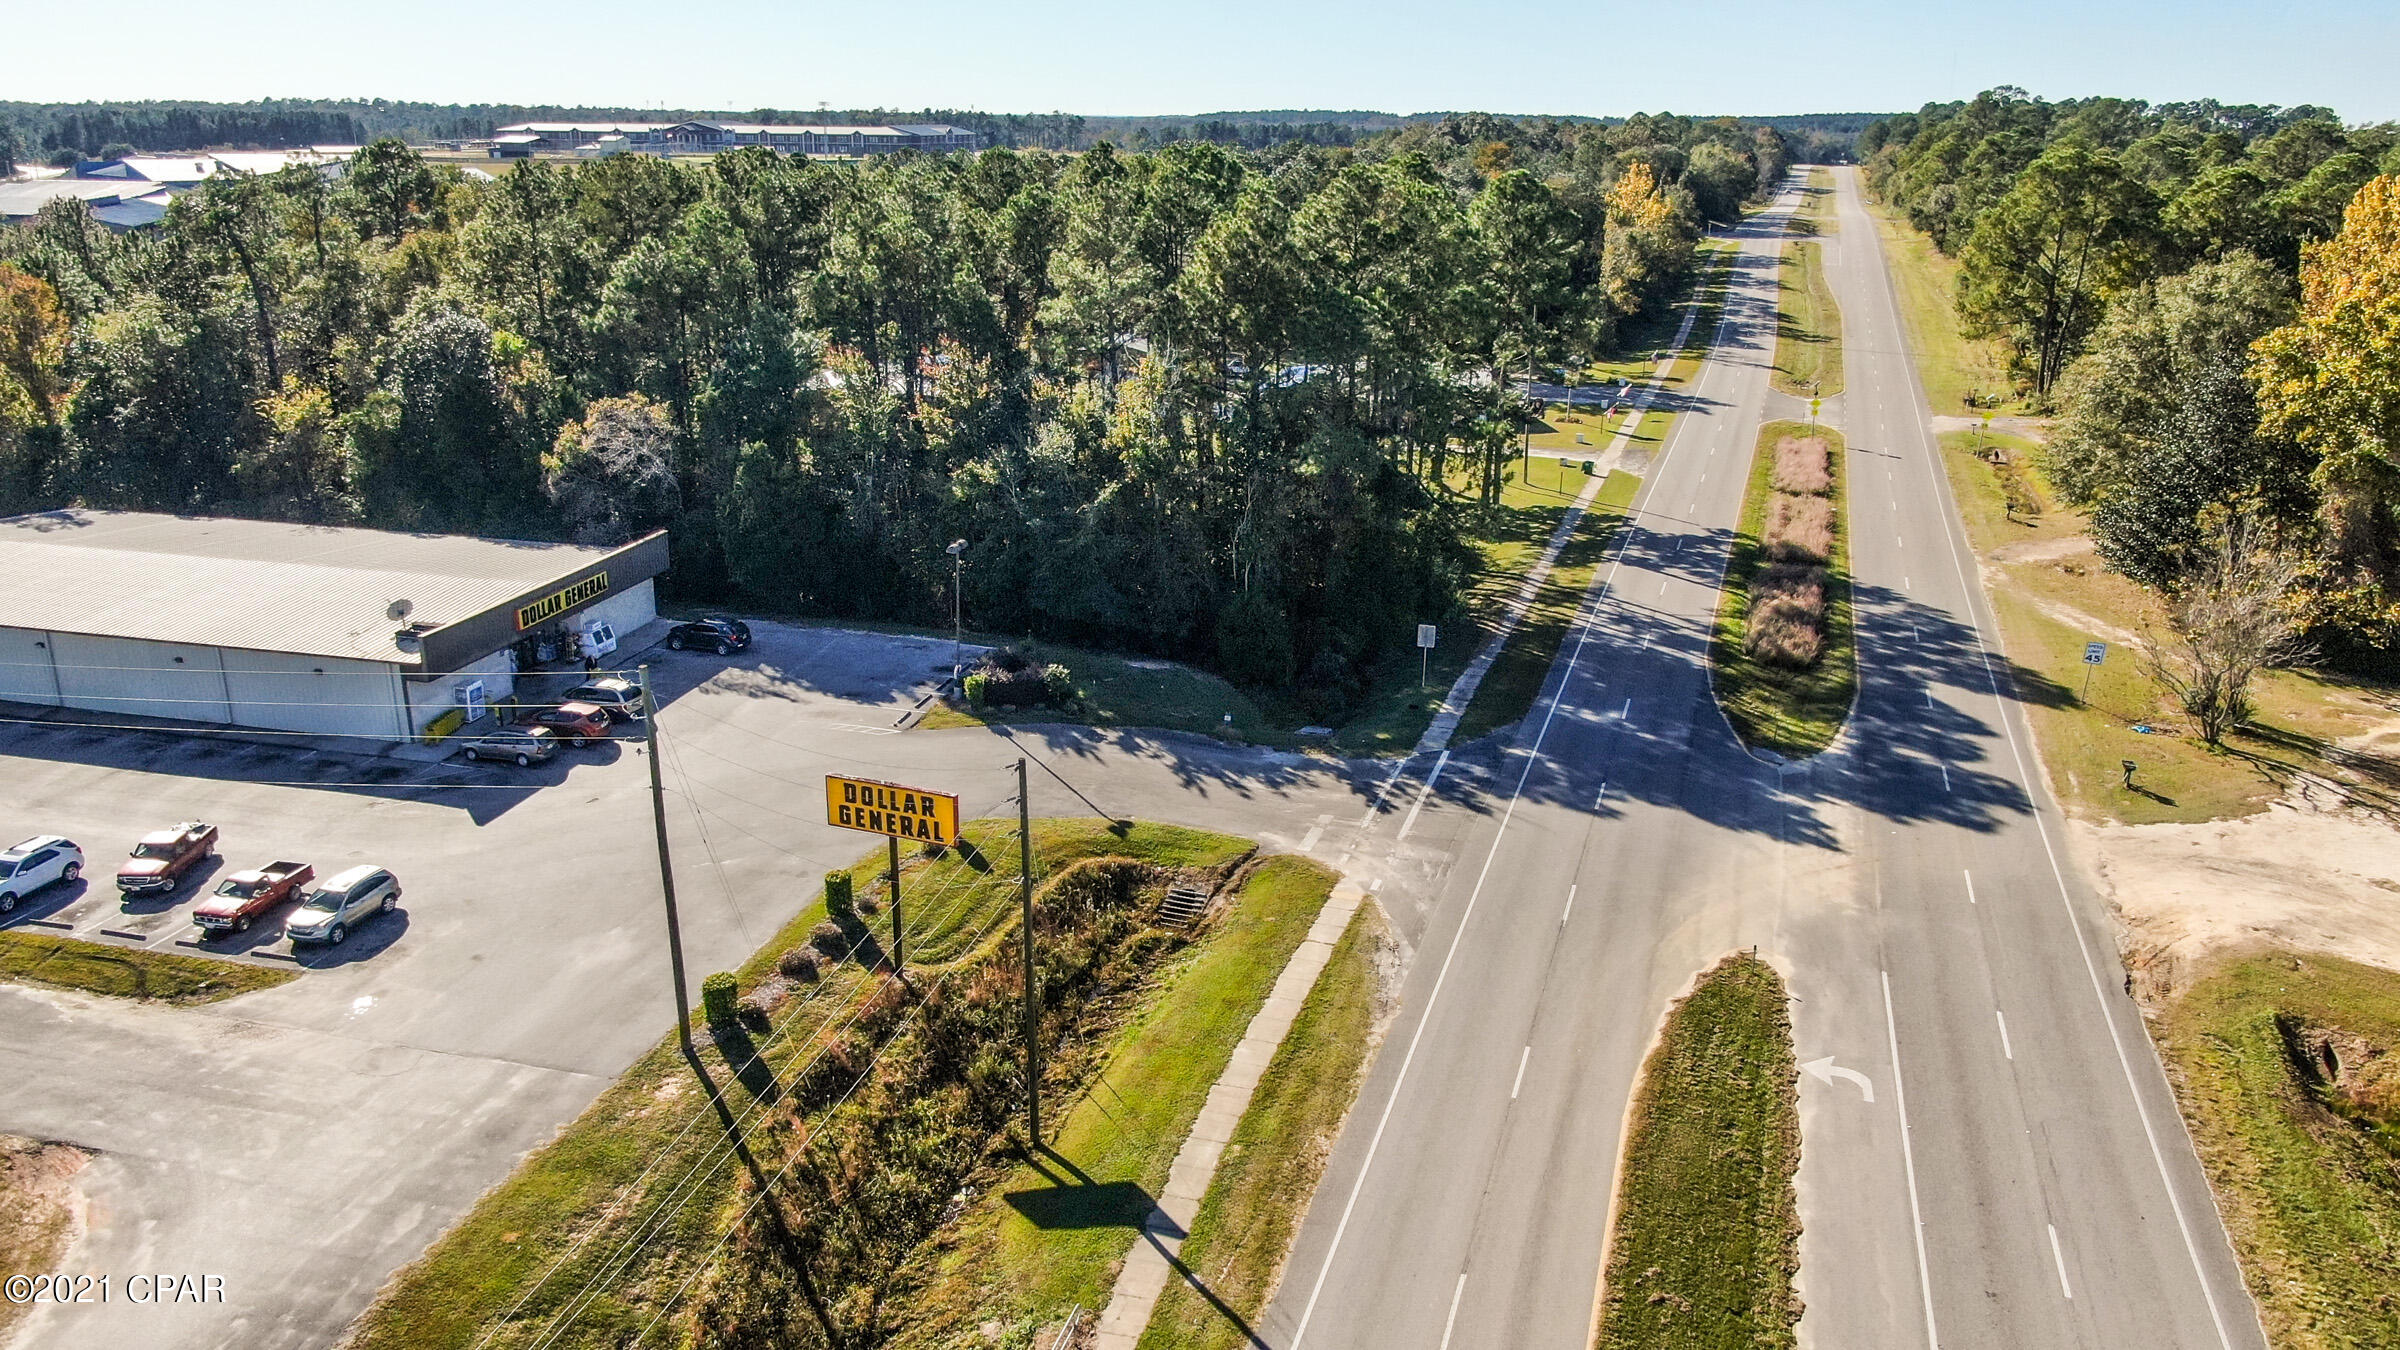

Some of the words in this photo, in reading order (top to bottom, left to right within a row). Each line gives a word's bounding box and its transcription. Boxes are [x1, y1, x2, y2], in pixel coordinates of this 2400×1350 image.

[521, 595, 562, 627] DOLLAR
[564, 574, 608, 607] GENERAL
[843, 782, 935, 818] DOLLAR
[838, 804, 944, 842] GENERAL
